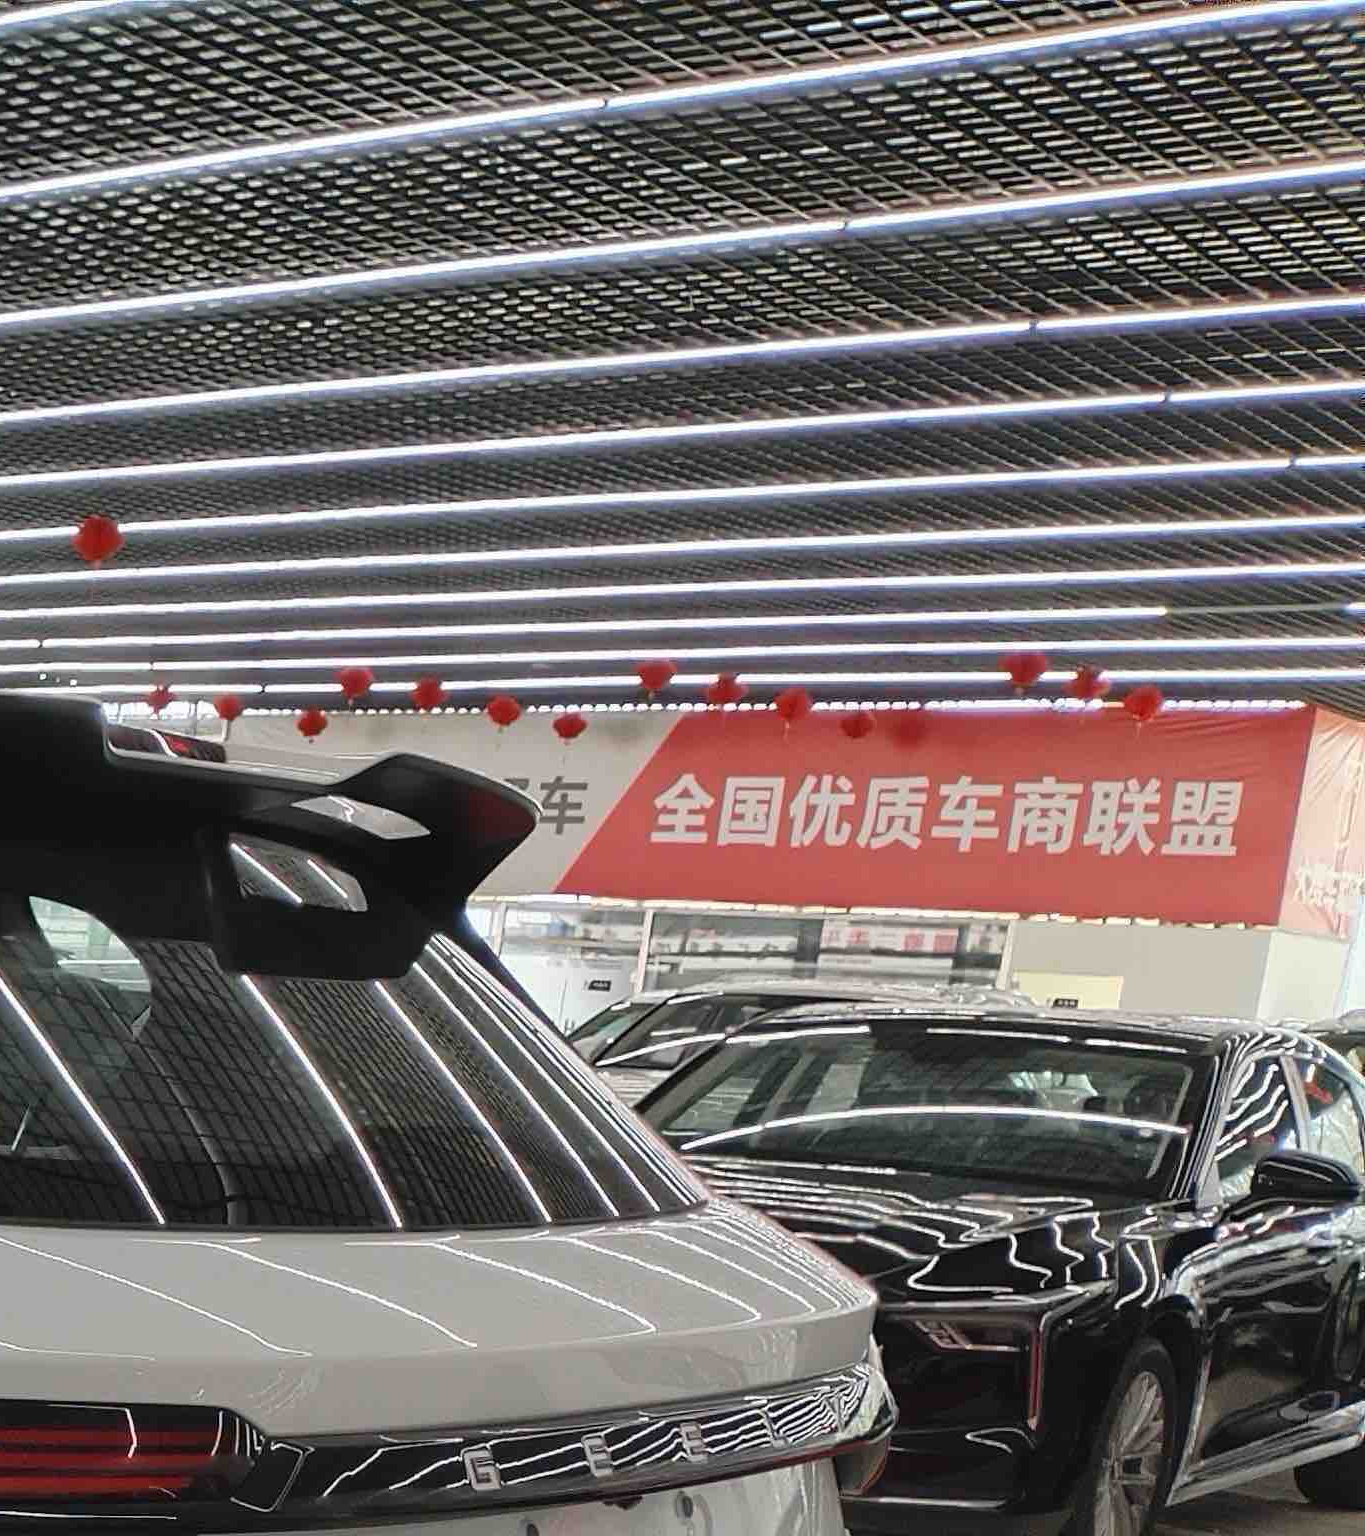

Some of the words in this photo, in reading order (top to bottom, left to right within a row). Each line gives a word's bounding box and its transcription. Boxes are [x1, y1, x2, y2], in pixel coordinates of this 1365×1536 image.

[650, 773, 1244, 857] 全国优质车商联盟
